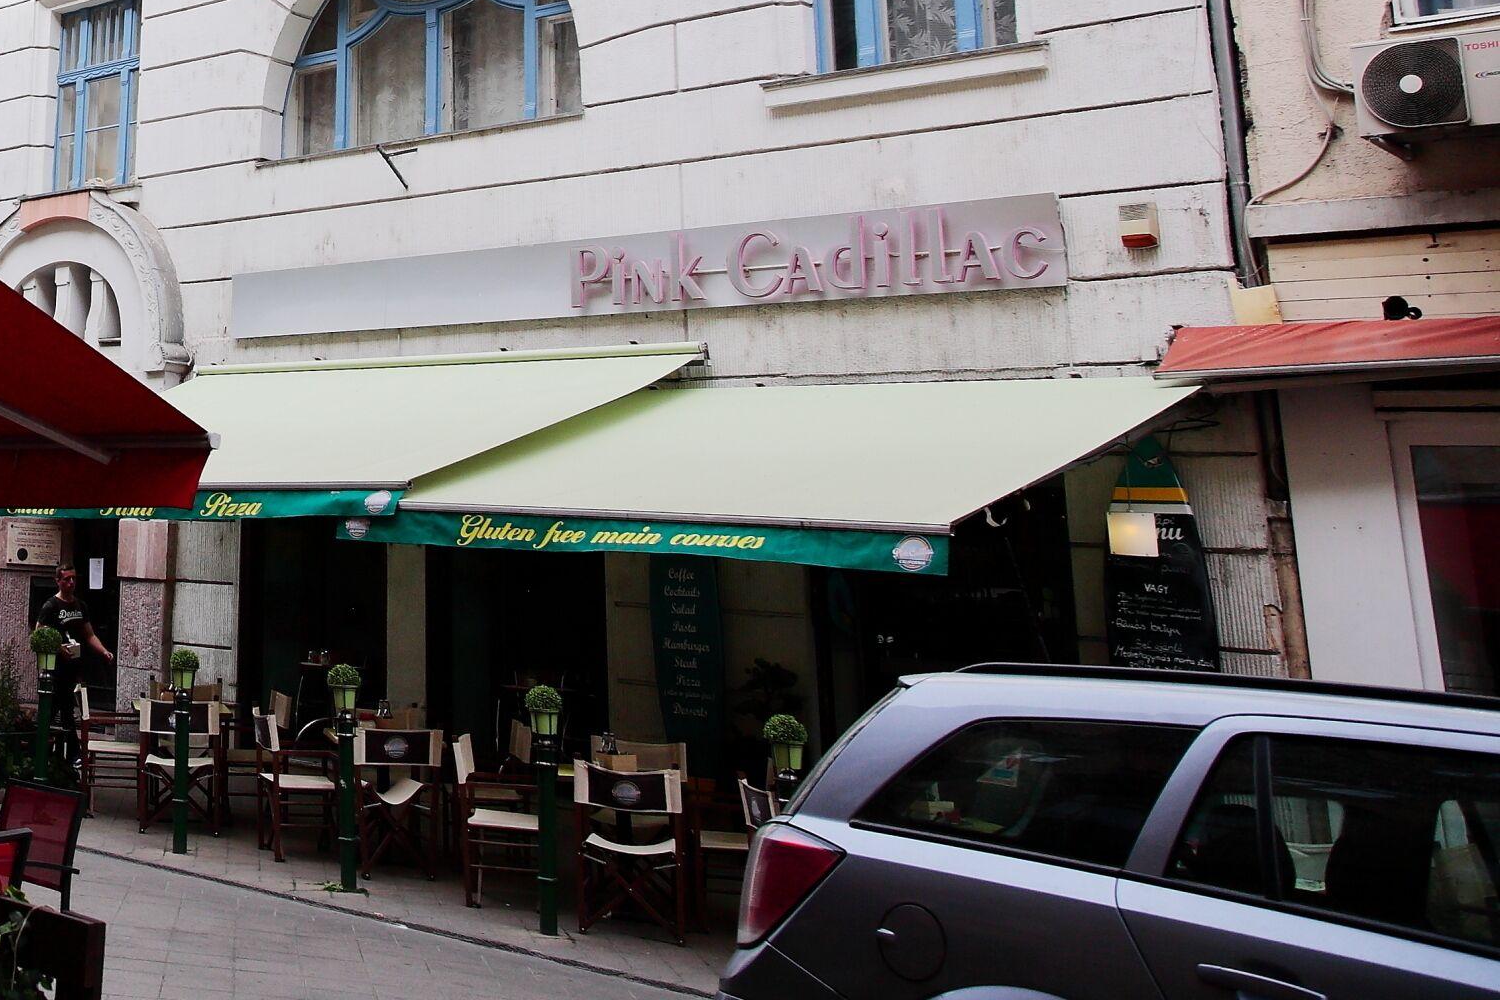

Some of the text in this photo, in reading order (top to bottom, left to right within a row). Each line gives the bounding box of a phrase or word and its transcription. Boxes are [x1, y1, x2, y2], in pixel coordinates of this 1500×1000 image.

[200, 492, 264, 518] Pizza
[457, 514, 767, 550] Gluten free main courses
[1156, 527, 1185, 541] nu
[668, 567, 696, 582] Coffee
[1143, 583, 1170, 595] VAGY
[671, 601, 696, 616] Salad
